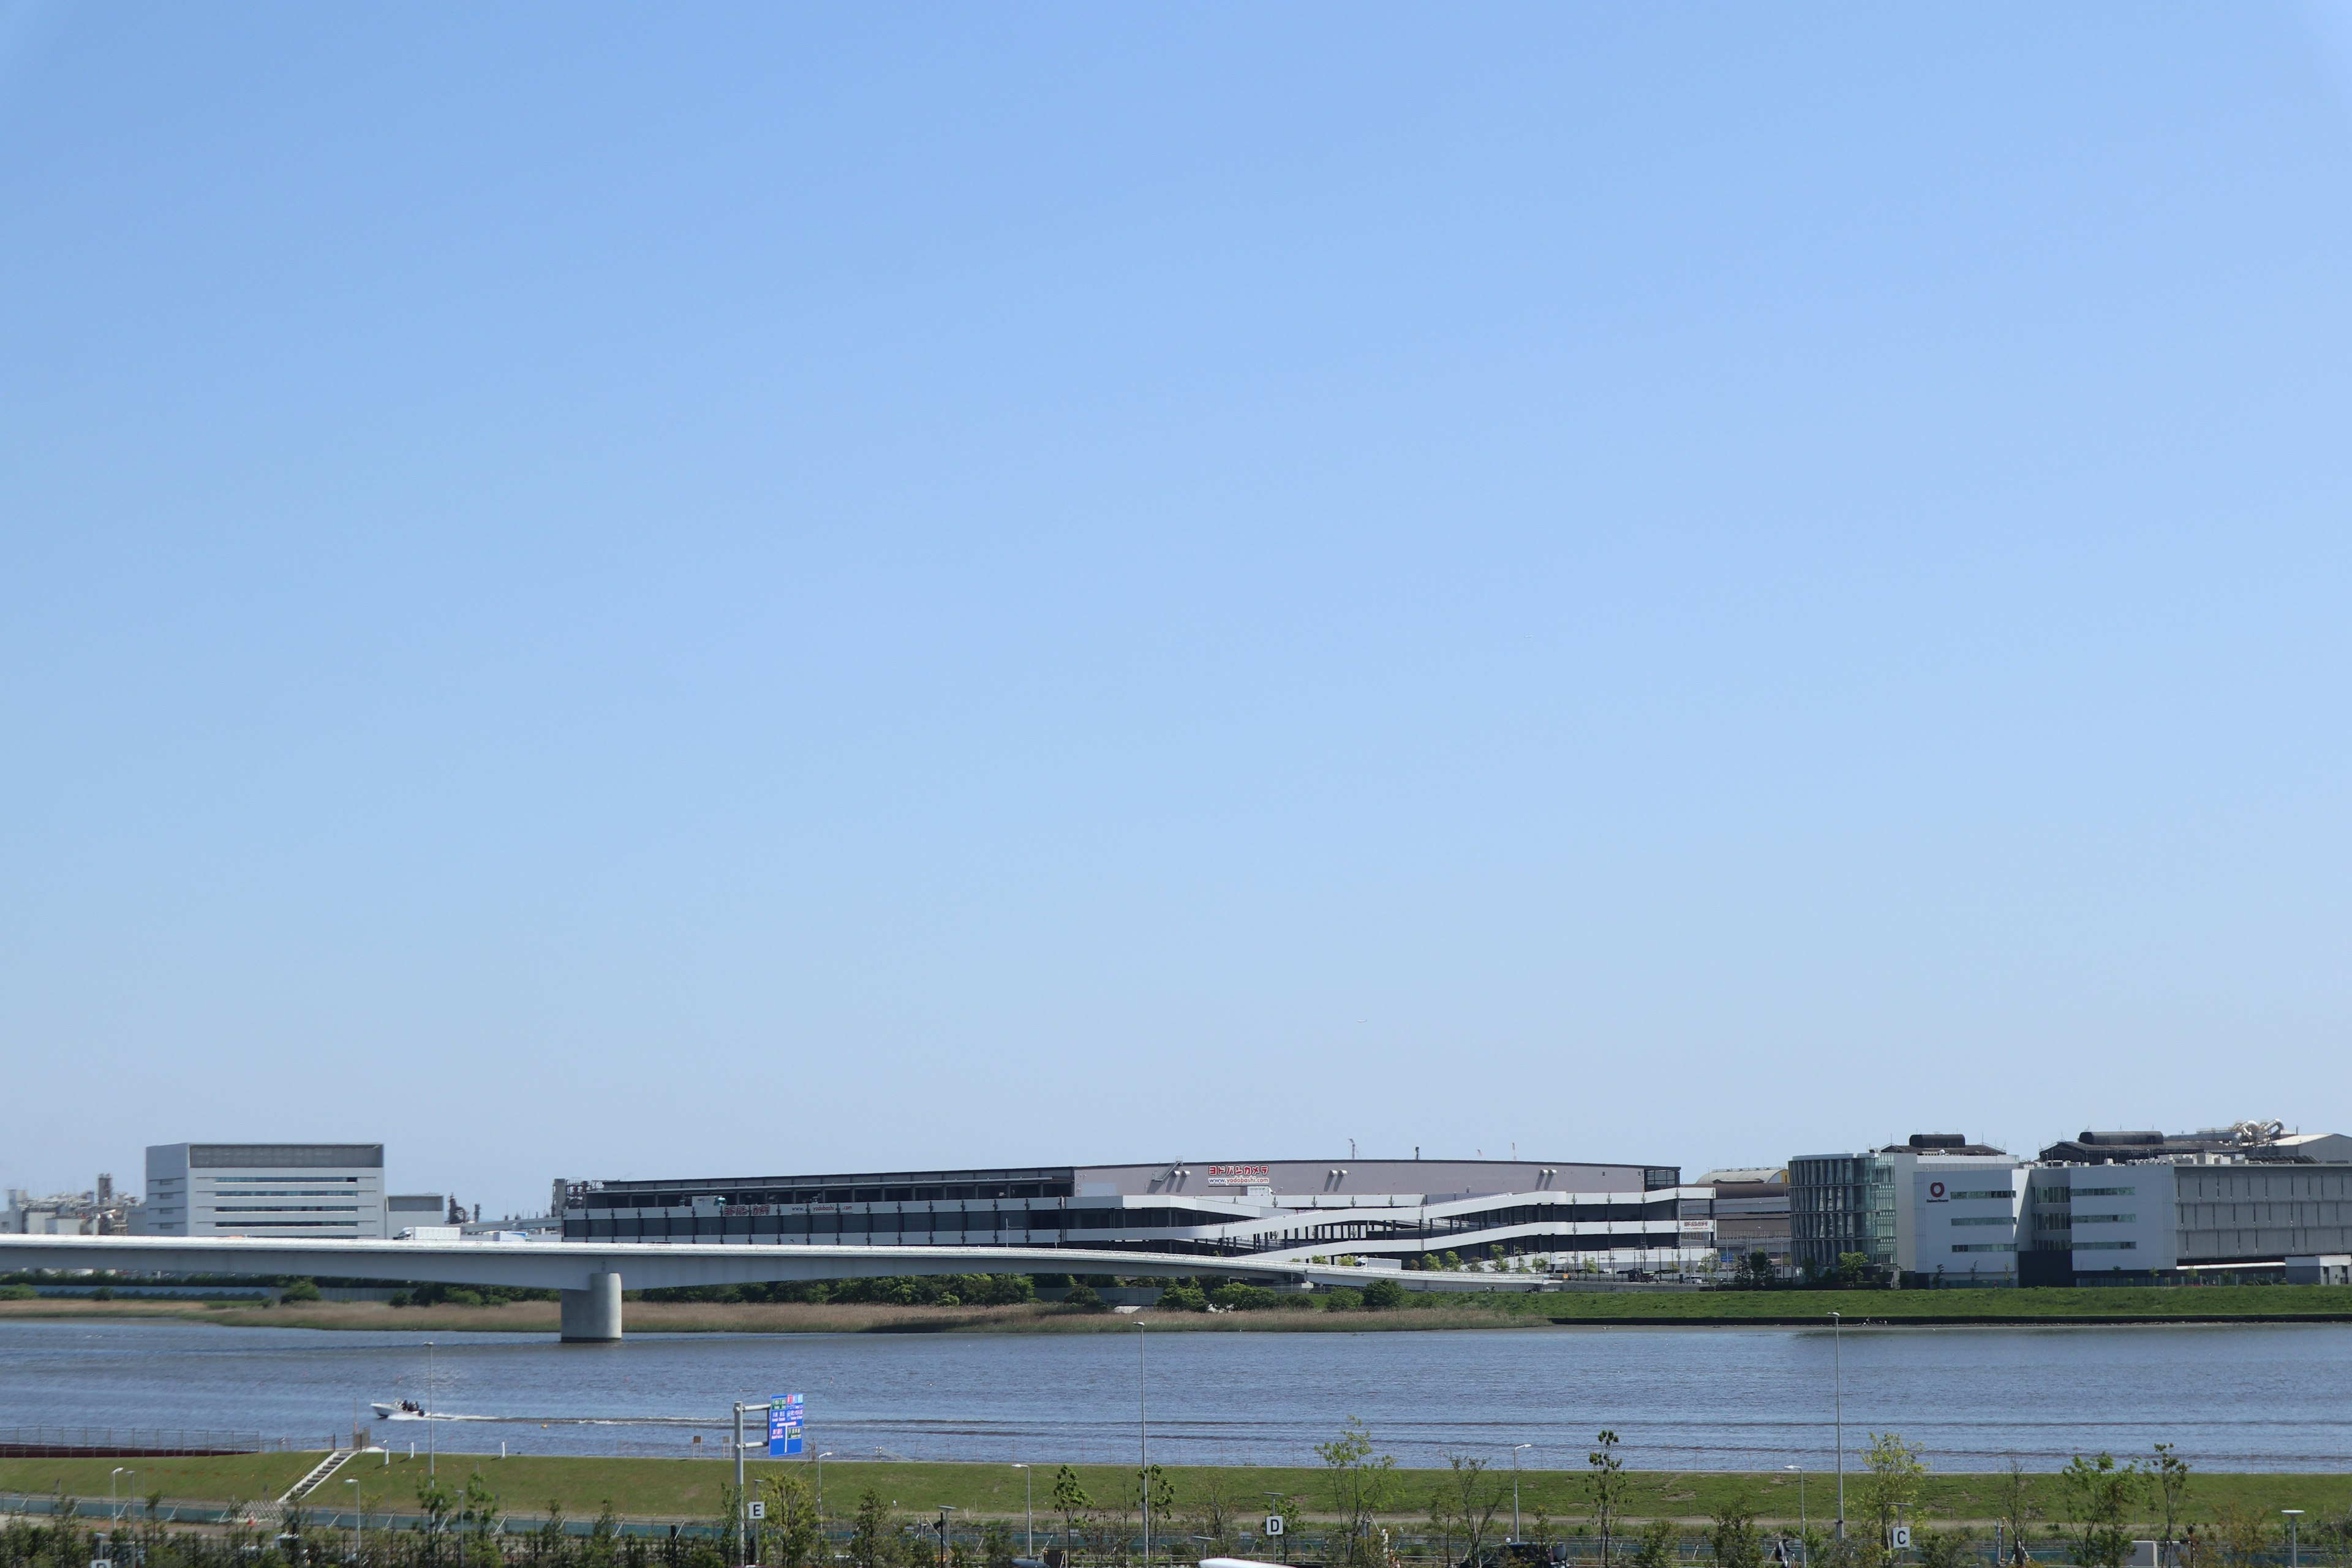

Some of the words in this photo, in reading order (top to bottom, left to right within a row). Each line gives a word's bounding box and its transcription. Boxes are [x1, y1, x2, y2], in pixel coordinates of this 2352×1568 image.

[1209, 1165, 1268, 1175] ヨドバシカメラ
[1208, 1176, 1269, 1185] www.yodobashi.com
[753, 1504, 761, 1516] E
[1270, 1519, 1280, 1532] D
[1897, 1531, 1906, 1545] C
